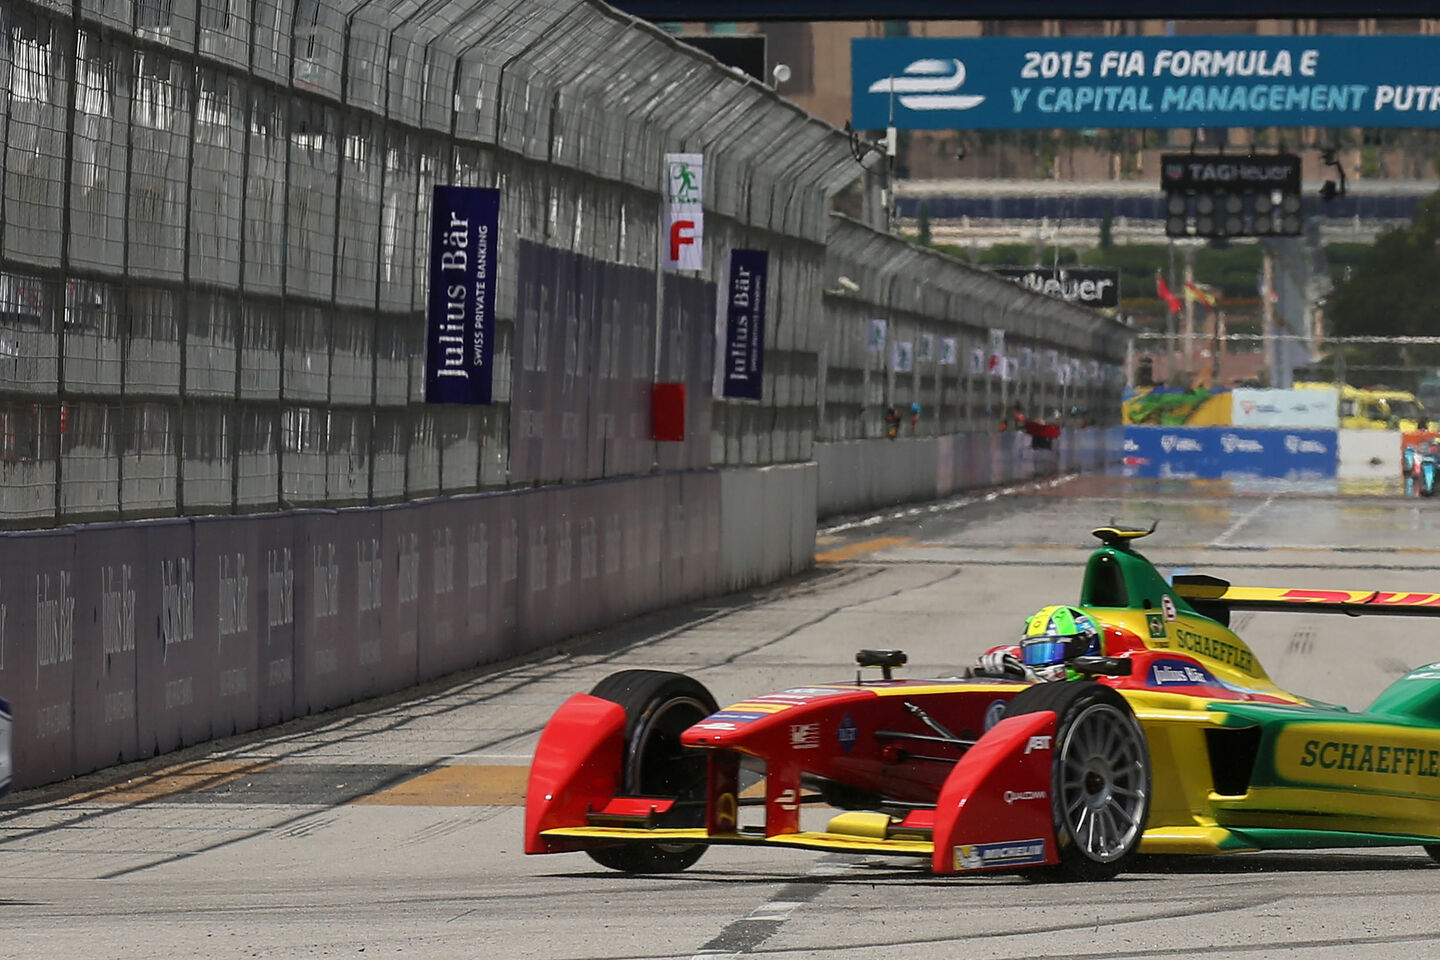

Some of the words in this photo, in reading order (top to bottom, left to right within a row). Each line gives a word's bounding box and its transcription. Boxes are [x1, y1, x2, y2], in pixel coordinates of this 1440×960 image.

[1021, 51, 1094, 78] 2015
[1100, 50, 1145, 78] FIA
[1153, 49, 1292, 77] FORMULA
[1300, 49, 1319, 77] E
[1010, 87, 1032, 113] Y
[1037, 86, 1153, 112] CAPITAL
[1160, 84, 1369, 112] MANAGEMENT
[441, 211, 469, 272] Bär
[476, 225, 489, 279] BANKING
[670, 221, 695, 261] F
[475, 281, 486, 330] PRIVATE
[438, 284, 469, 378] Julius
[474, 333, 485, 366] SWISS
[1176, 628, 1252, 673] SCHAEFFLER
[1153, 664, 1189, 685] Julius
[1184, 666, 1207, 683] Bär
[1024, 735, 1052, 755] ABT
[983, 843, 1044, 860] MICHELIN
